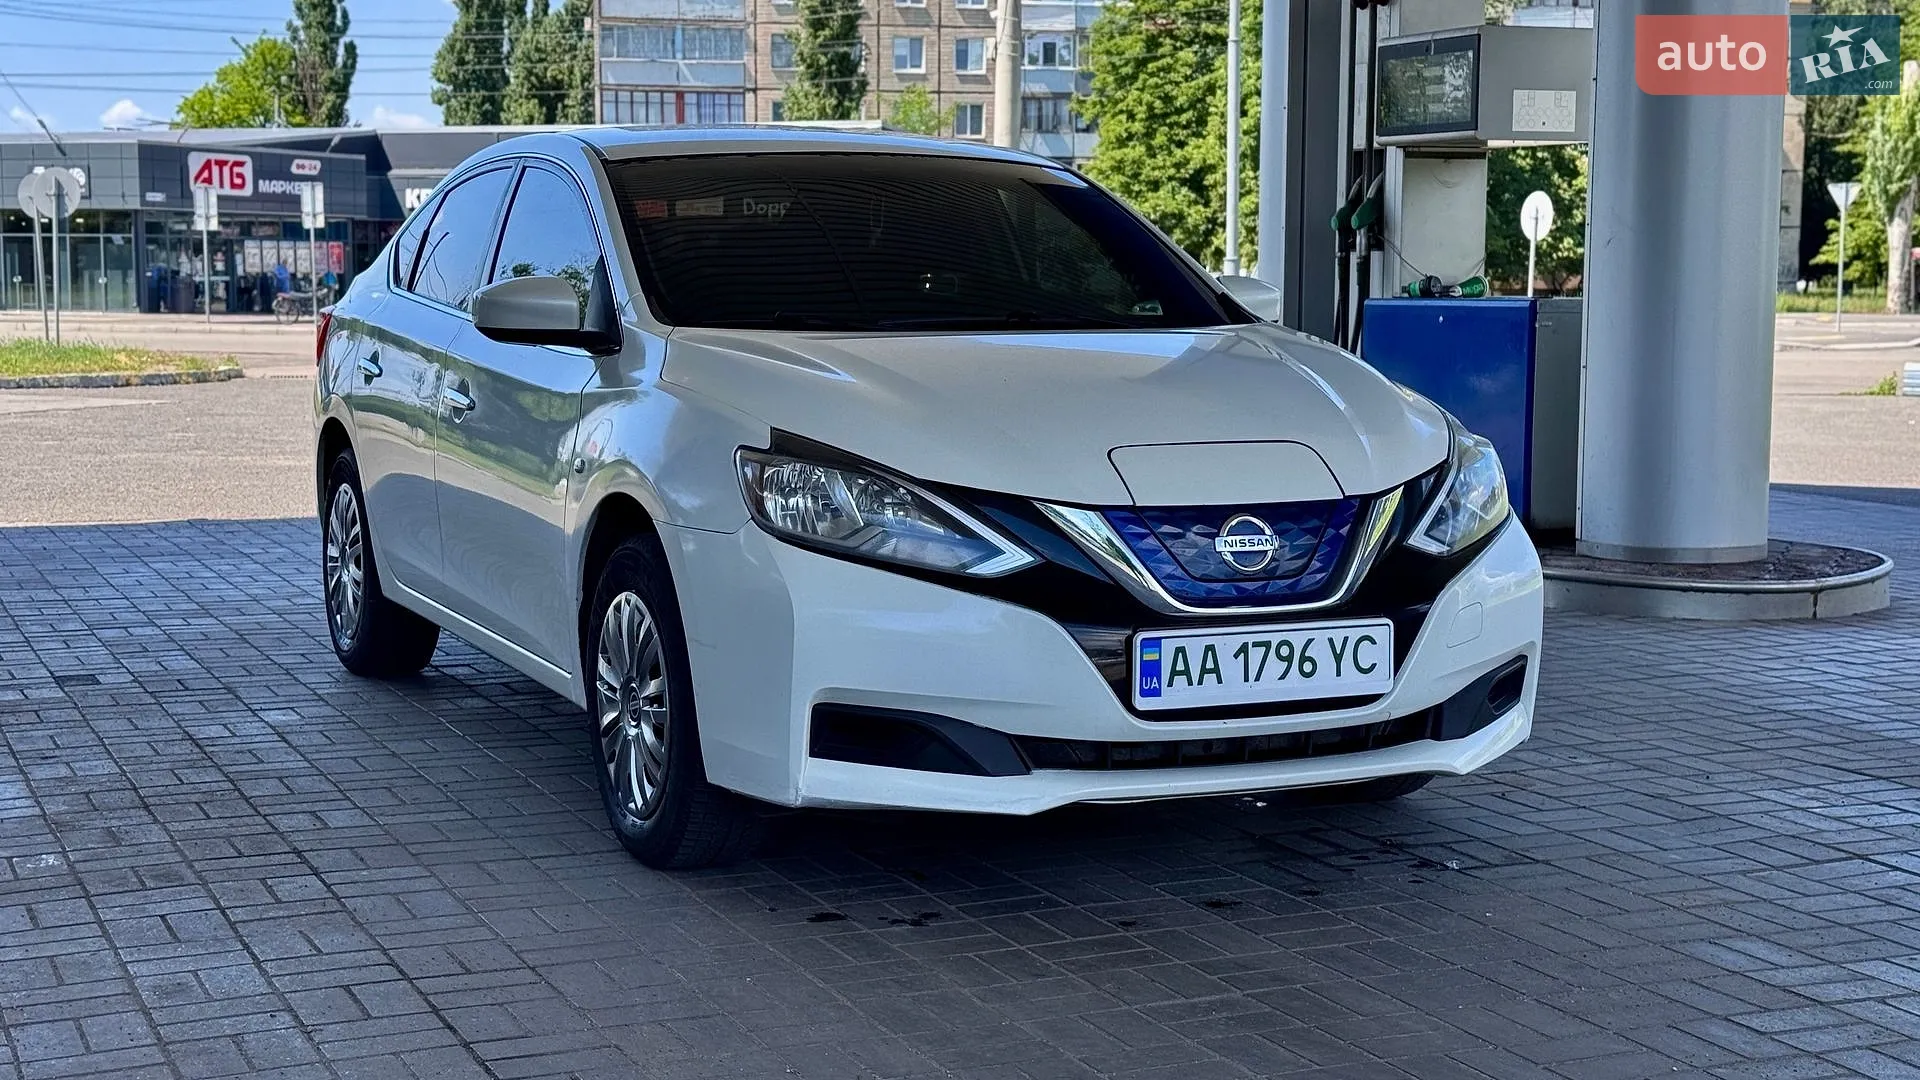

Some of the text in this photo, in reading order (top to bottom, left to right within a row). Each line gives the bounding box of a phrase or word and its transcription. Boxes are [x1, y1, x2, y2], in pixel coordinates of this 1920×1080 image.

[194, 158, 247, 190] АТБ
[258, 179, 303, 195] МАРКЕ
[1223, 536, 1274, 549] NISSAN
[1166, 634, 1378, 688] AA 1796 YC
[1142, 676, 1160, 690] UA
